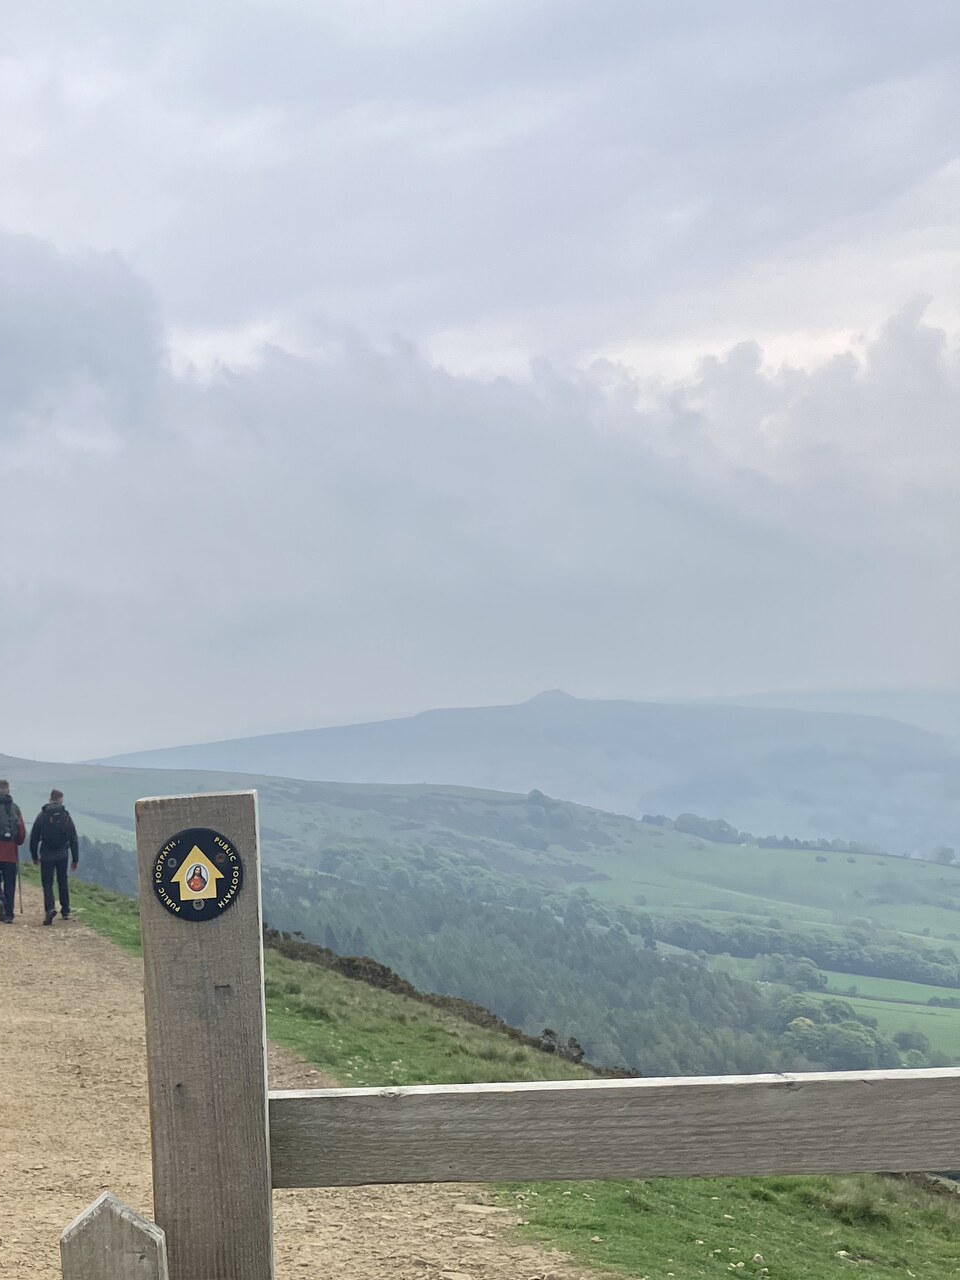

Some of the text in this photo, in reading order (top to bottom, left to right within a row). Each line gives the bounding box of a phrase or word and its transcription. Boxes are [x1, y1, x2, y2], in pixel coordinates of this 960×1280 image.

[155, 841, 181, 913] PUBLIC FOOTPATH
[214, 836, 239, 908] PUBLIC FOOTPATH
